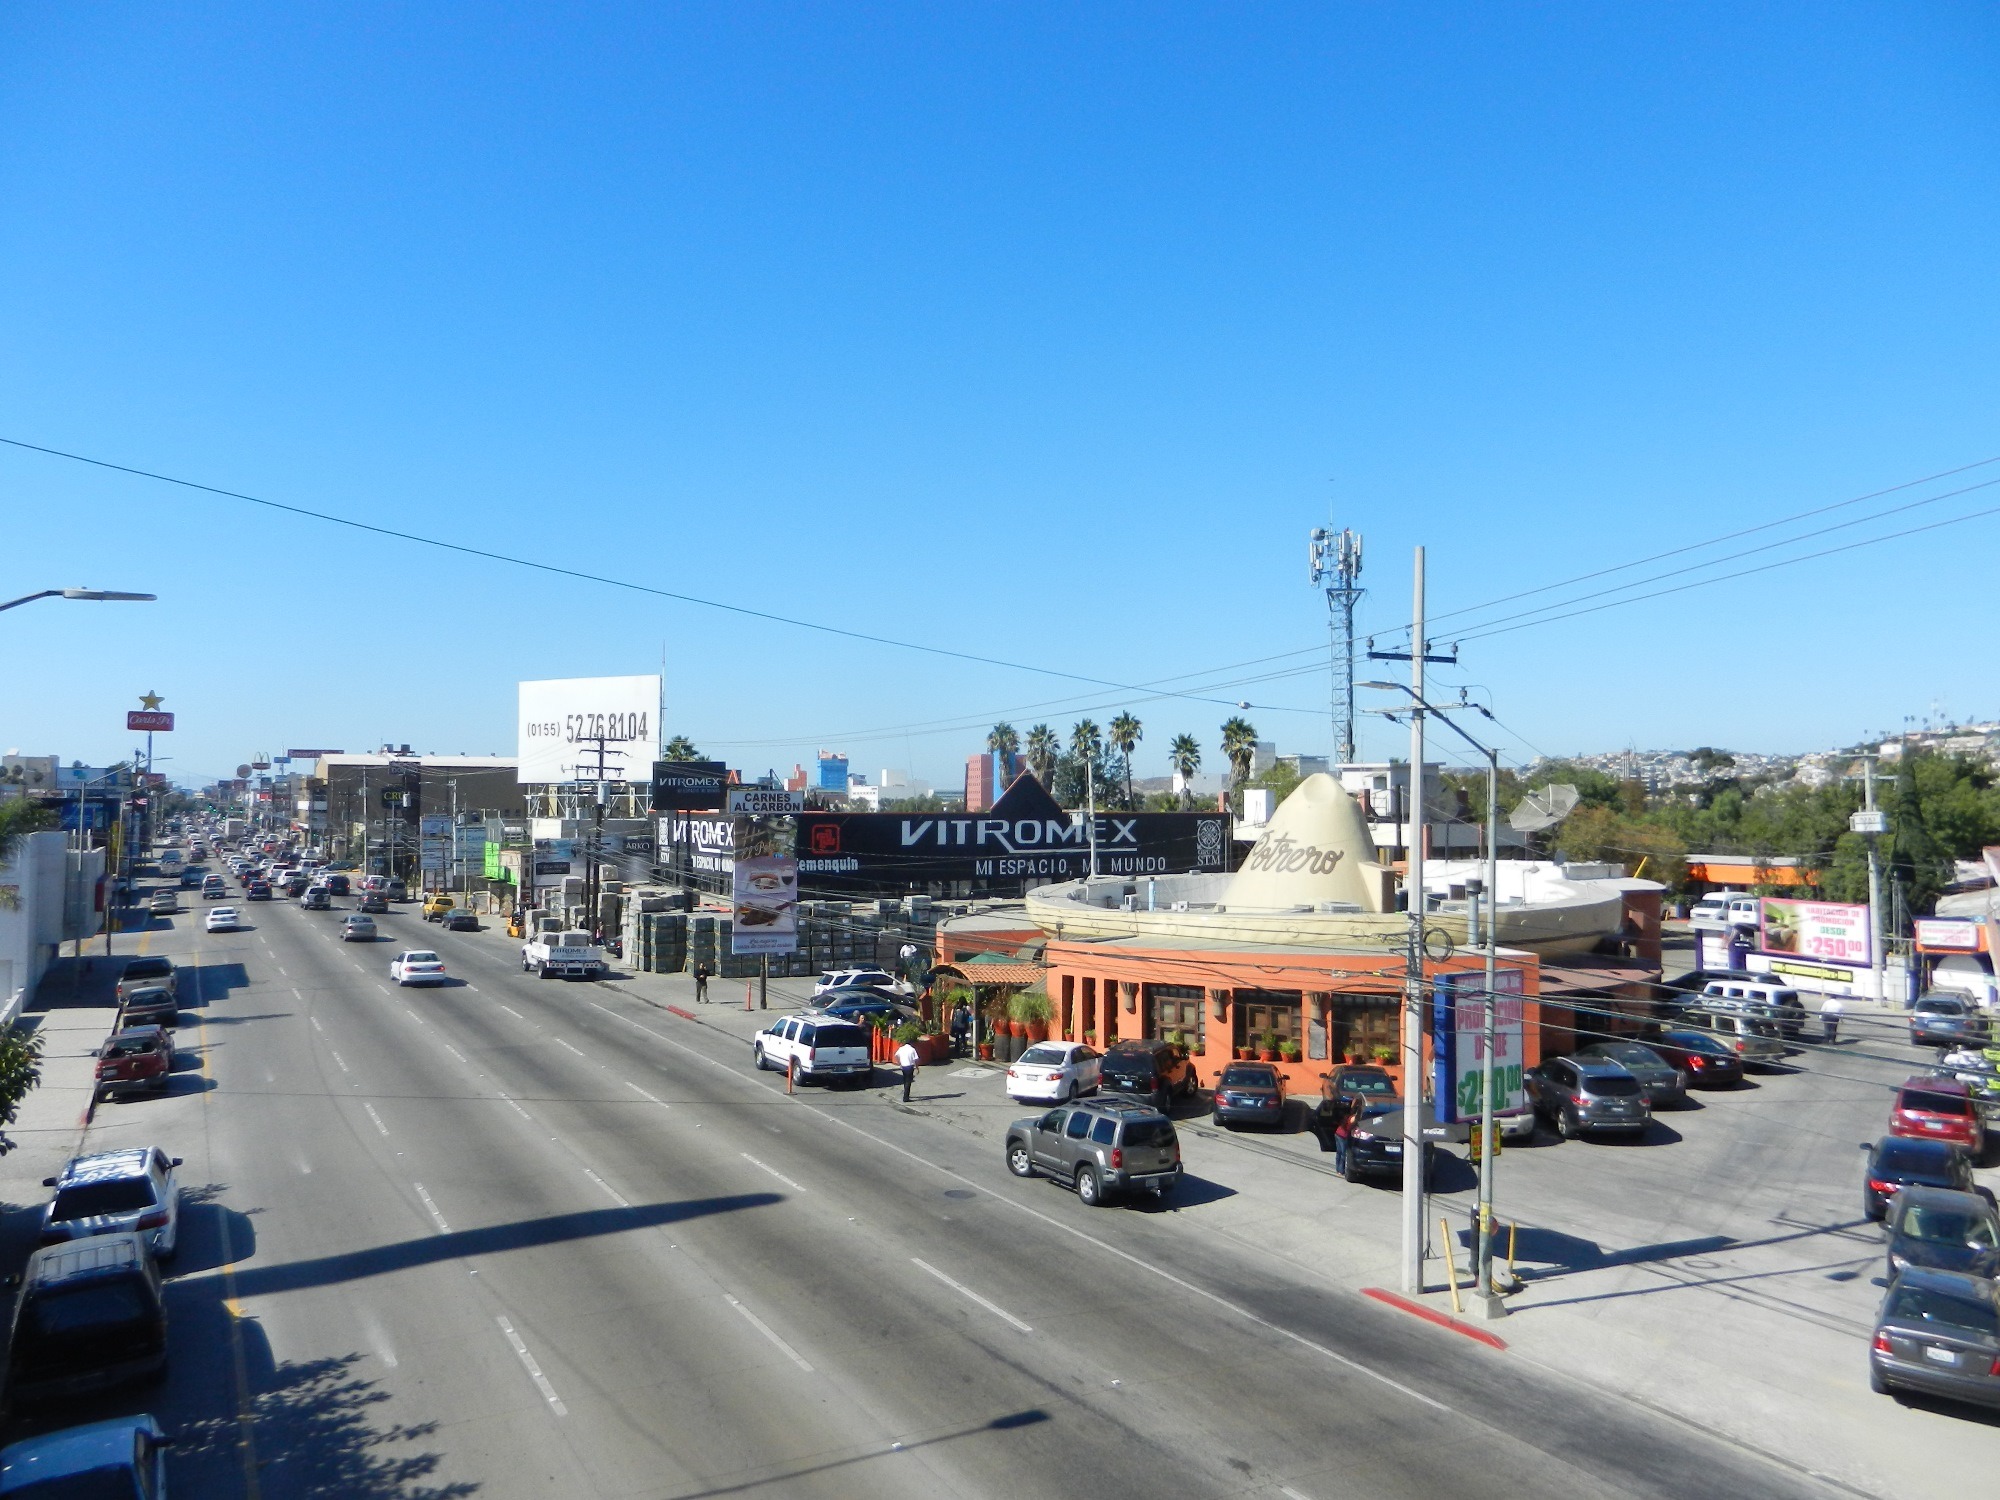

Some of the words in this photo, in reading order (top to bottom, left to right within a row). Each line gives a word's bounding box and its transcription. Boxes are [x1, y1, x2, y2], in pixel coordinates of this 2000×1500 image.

[527, 722, 561, 737] (0155)
[659, 777, 720, 788] VITROMEX
[744, 793, 791, 802] CARNES
[734, 802, 749, 812] AL
[752, 802, 801, 812] CARBON
[674, 820, 734, 853] VITROMEX
[901, 819, 1138, 853] VITROMEX
[1250, 830, 1345, 875] Potrero
[797, 856, 859, 873] emenquin
[975, 859, 993, 875] MI
[999, 858, 1073, 876] ESPACIO,
[1082, 857, 1100, 873] MI
[1111, 856, 1166, 872] MUNDO
[1197, 855, 1221, 866] STM
[1820, 926, 1847, 936] DESDE
